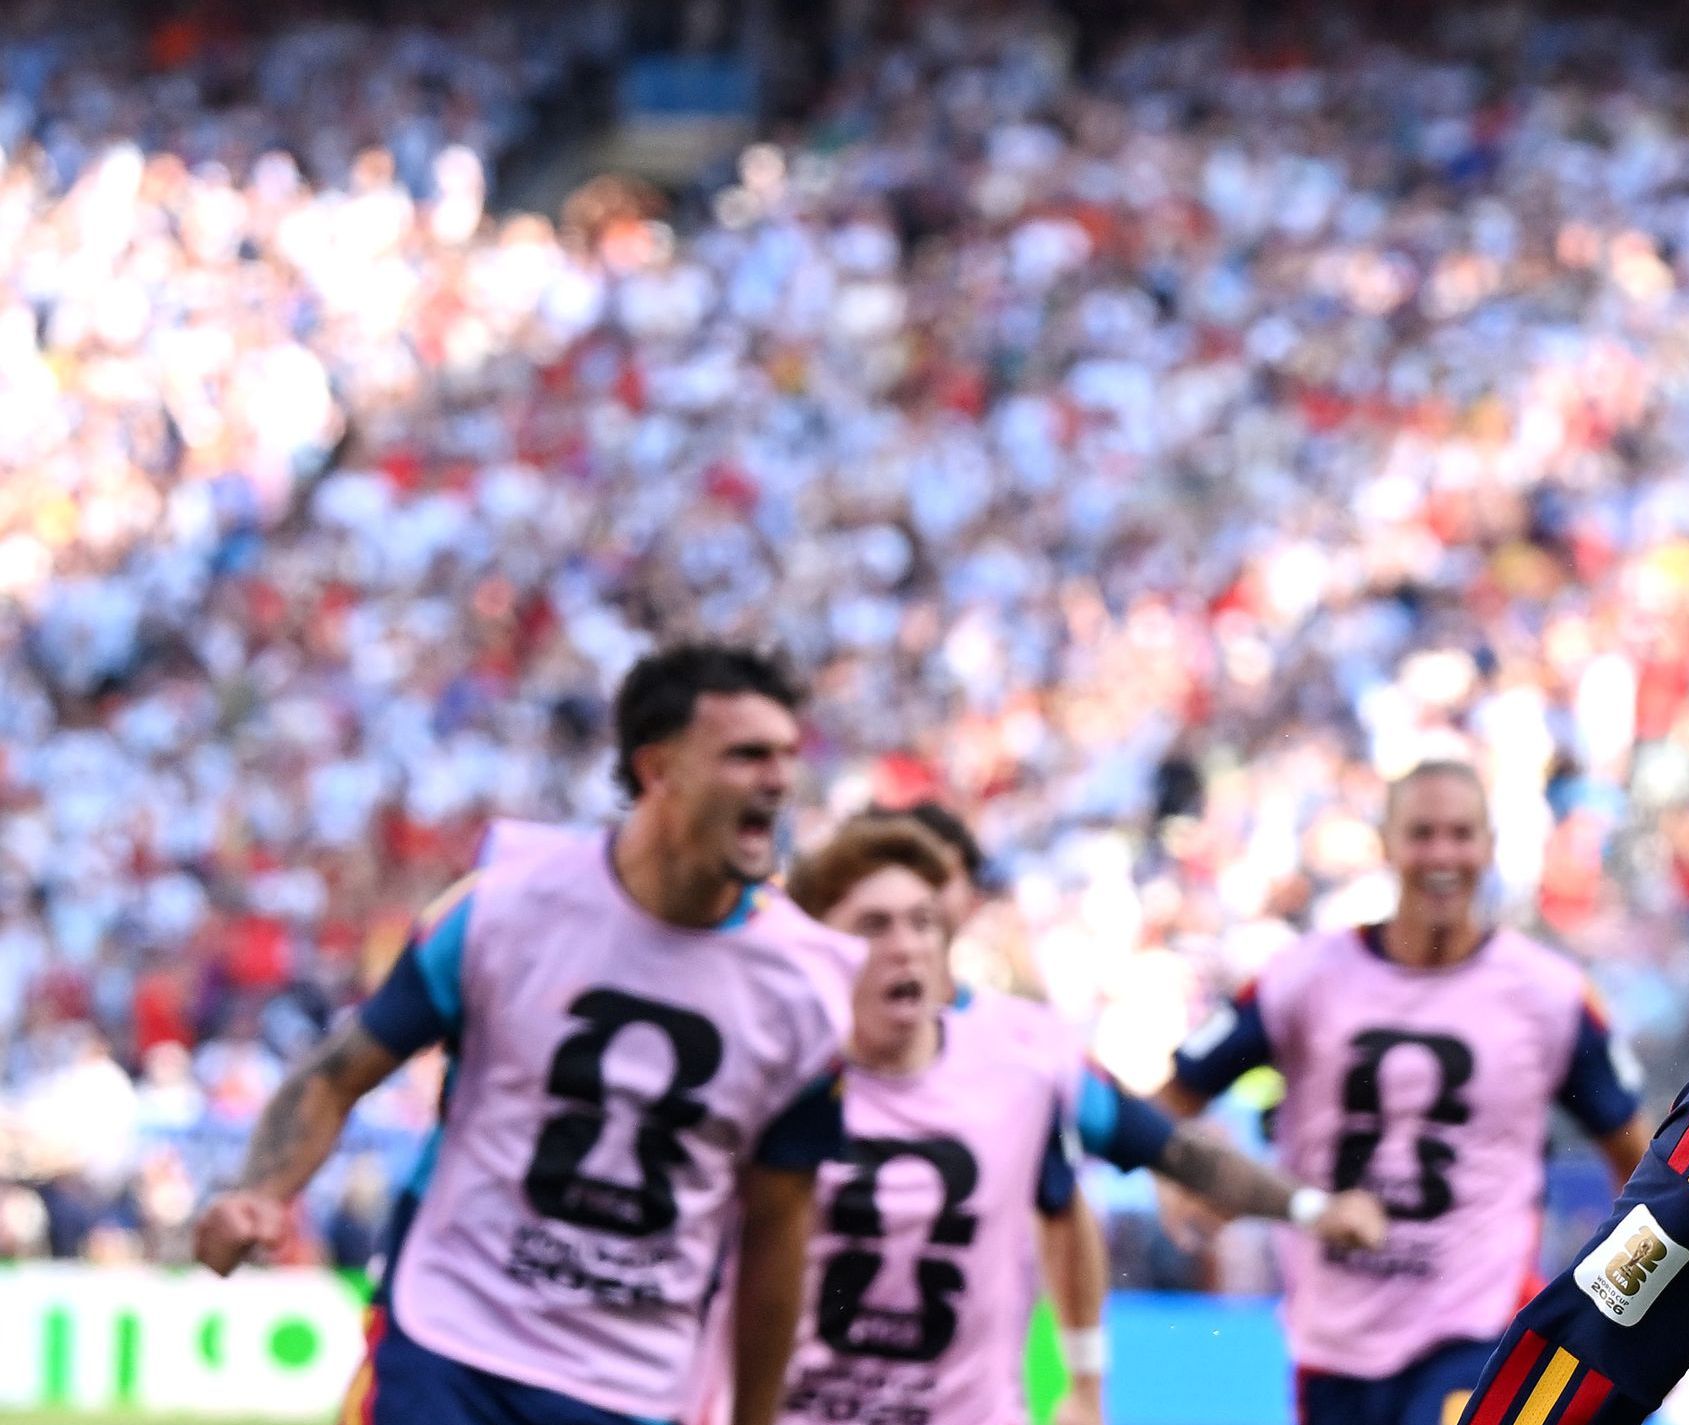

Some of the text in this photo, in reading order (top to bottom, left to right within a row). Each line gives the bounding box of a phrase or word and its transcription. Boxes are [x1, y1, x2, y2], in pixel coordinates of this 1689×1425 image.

[1597, 1275, 1630, 1306] WORLD CUP
[1612, 1270, 1629, 1289] FIFA
[1591, 1281, 1625, 1316] 2026
